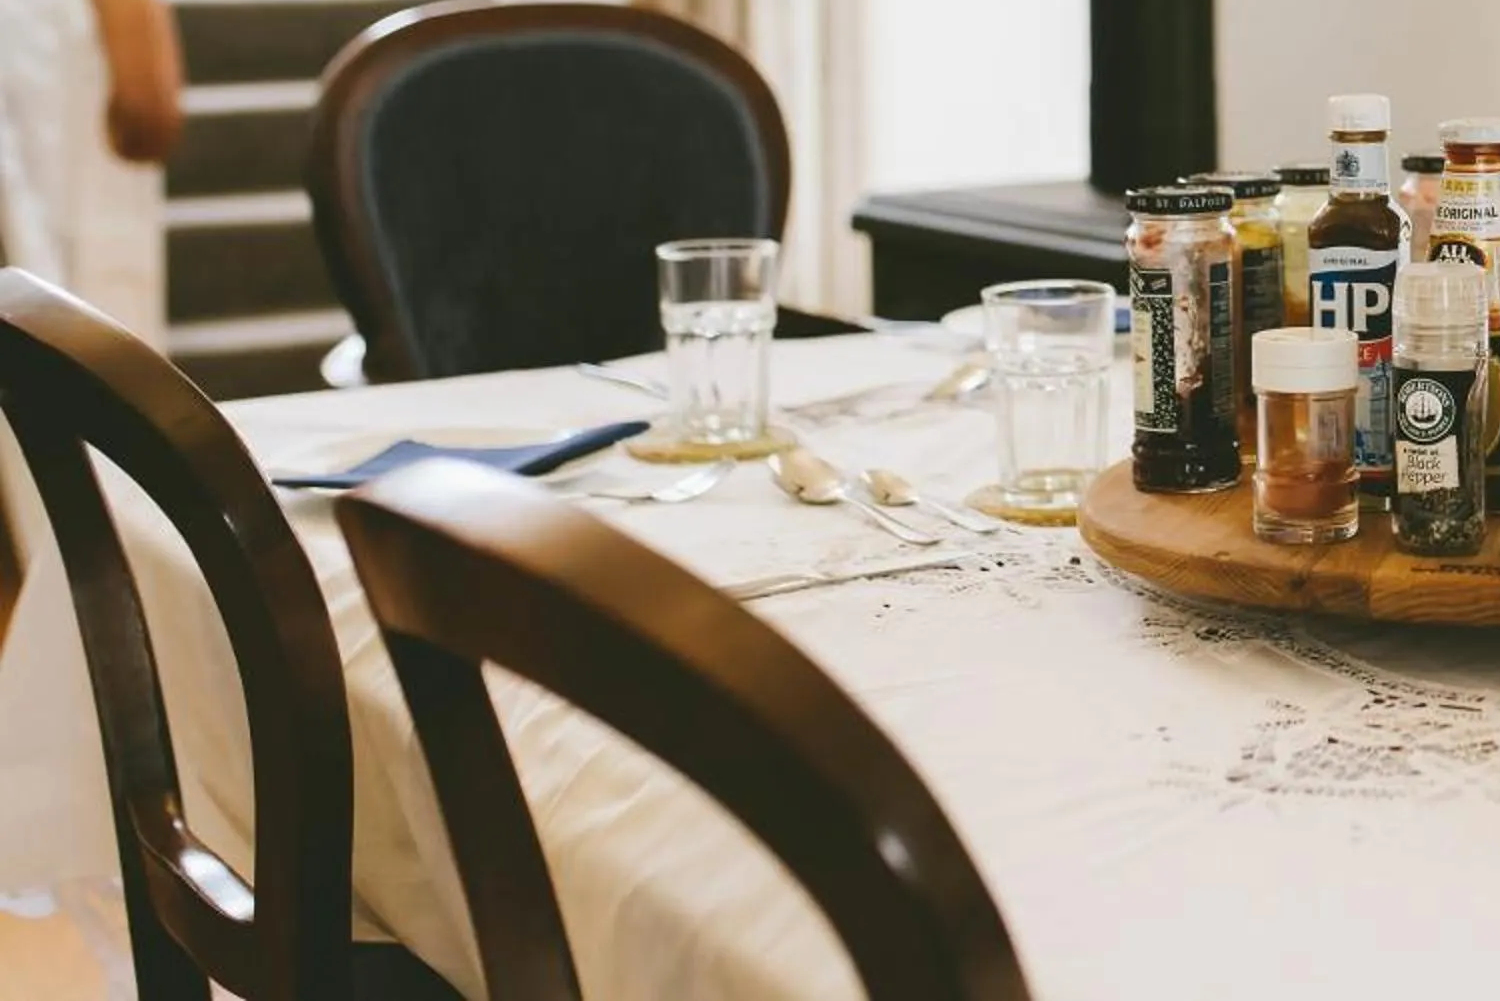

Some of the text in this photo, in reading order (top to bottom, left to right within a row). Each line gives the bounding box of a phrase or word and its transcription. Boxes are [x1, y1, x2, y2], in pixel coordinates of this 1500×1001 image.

[1443, 206, 1499, 220] ORIGINAL
[1440, 244, 1470, 260] ALL
[1312, 280, 1390, 332] HP
[1408, 454, 1441, 470] Black
